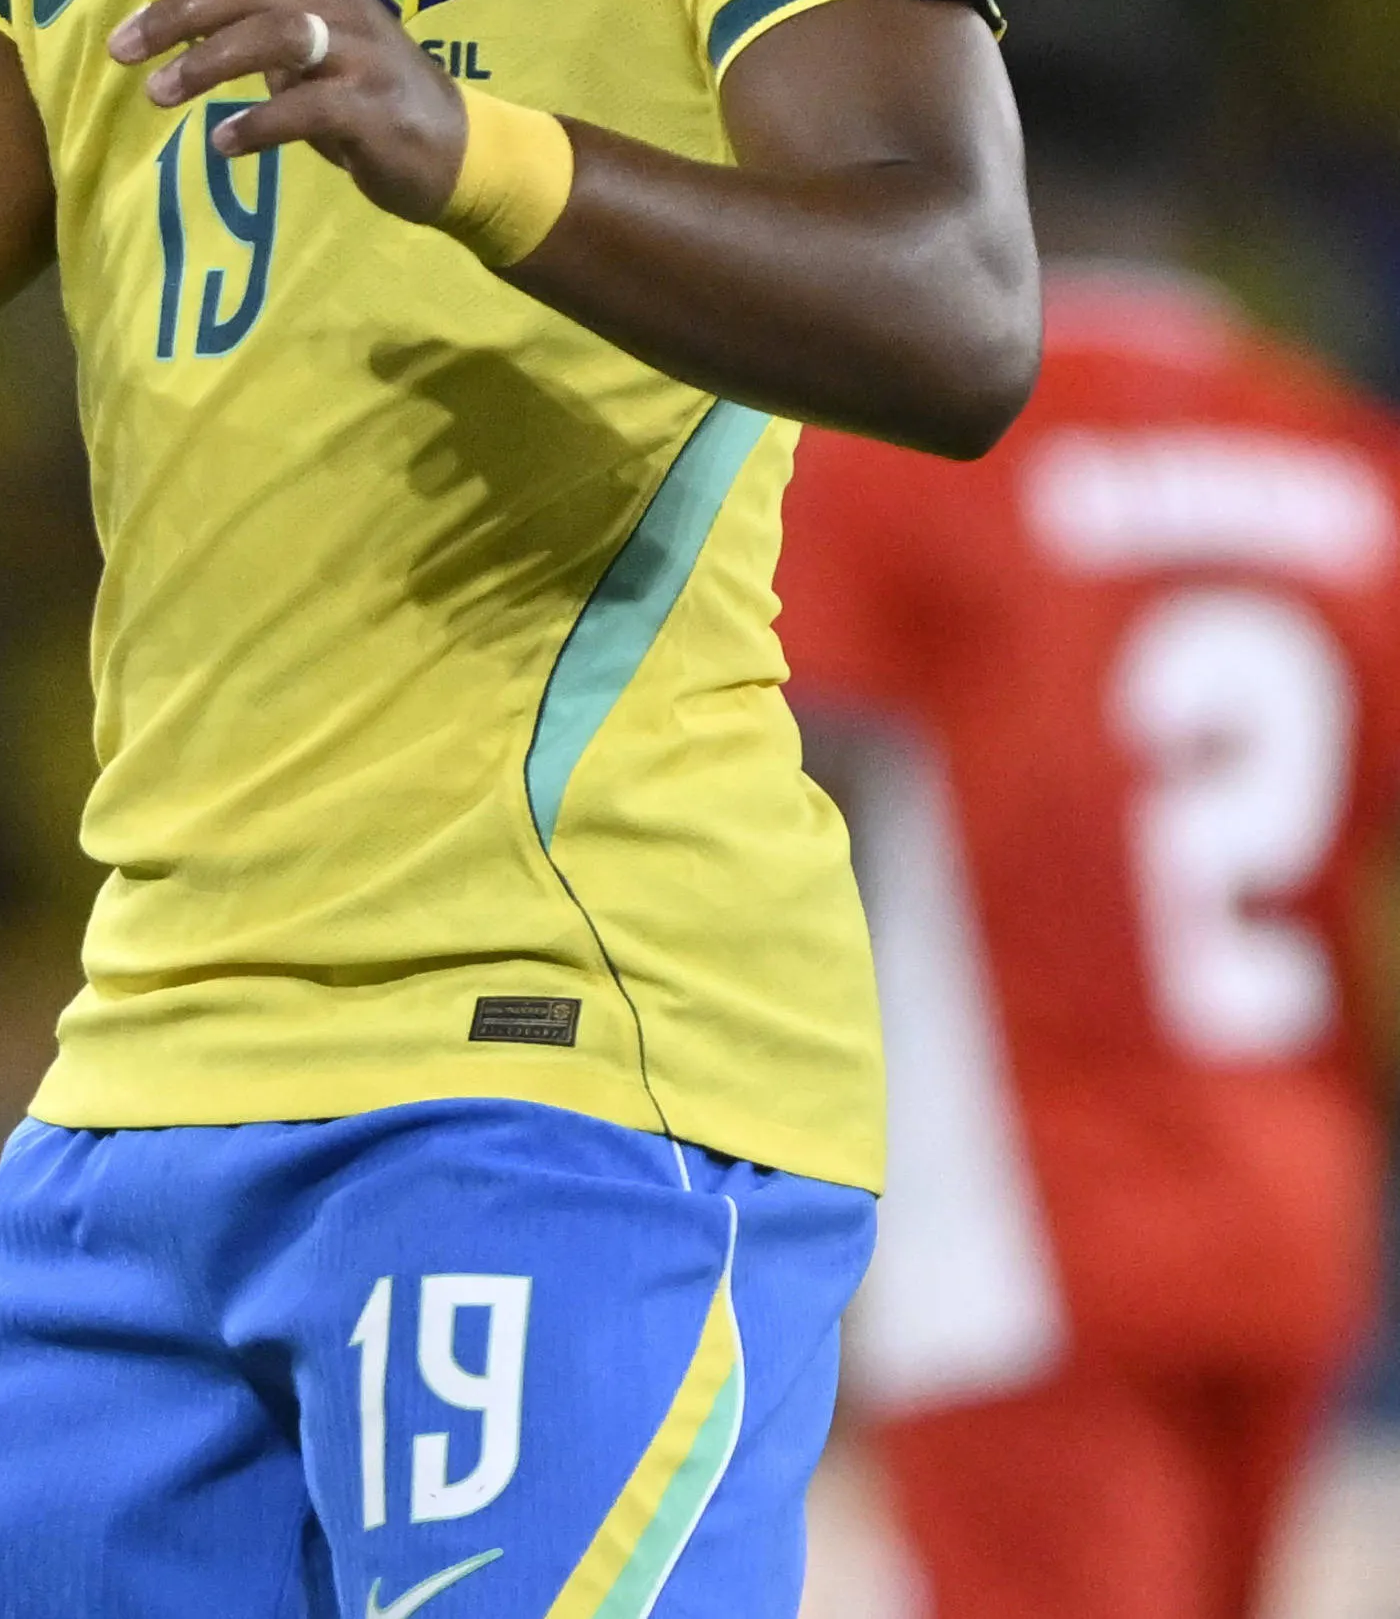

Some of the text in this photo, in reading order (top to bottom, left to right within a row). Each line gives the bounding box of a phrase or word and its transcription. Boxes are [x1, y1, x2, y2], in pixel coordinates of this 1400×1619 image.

[419, 38, 493, 81] SIL
[155, 96, 283, 362] 19
[1112, 588, 1358, 1068] 2
[348, 1272, 533, 1532] 19
